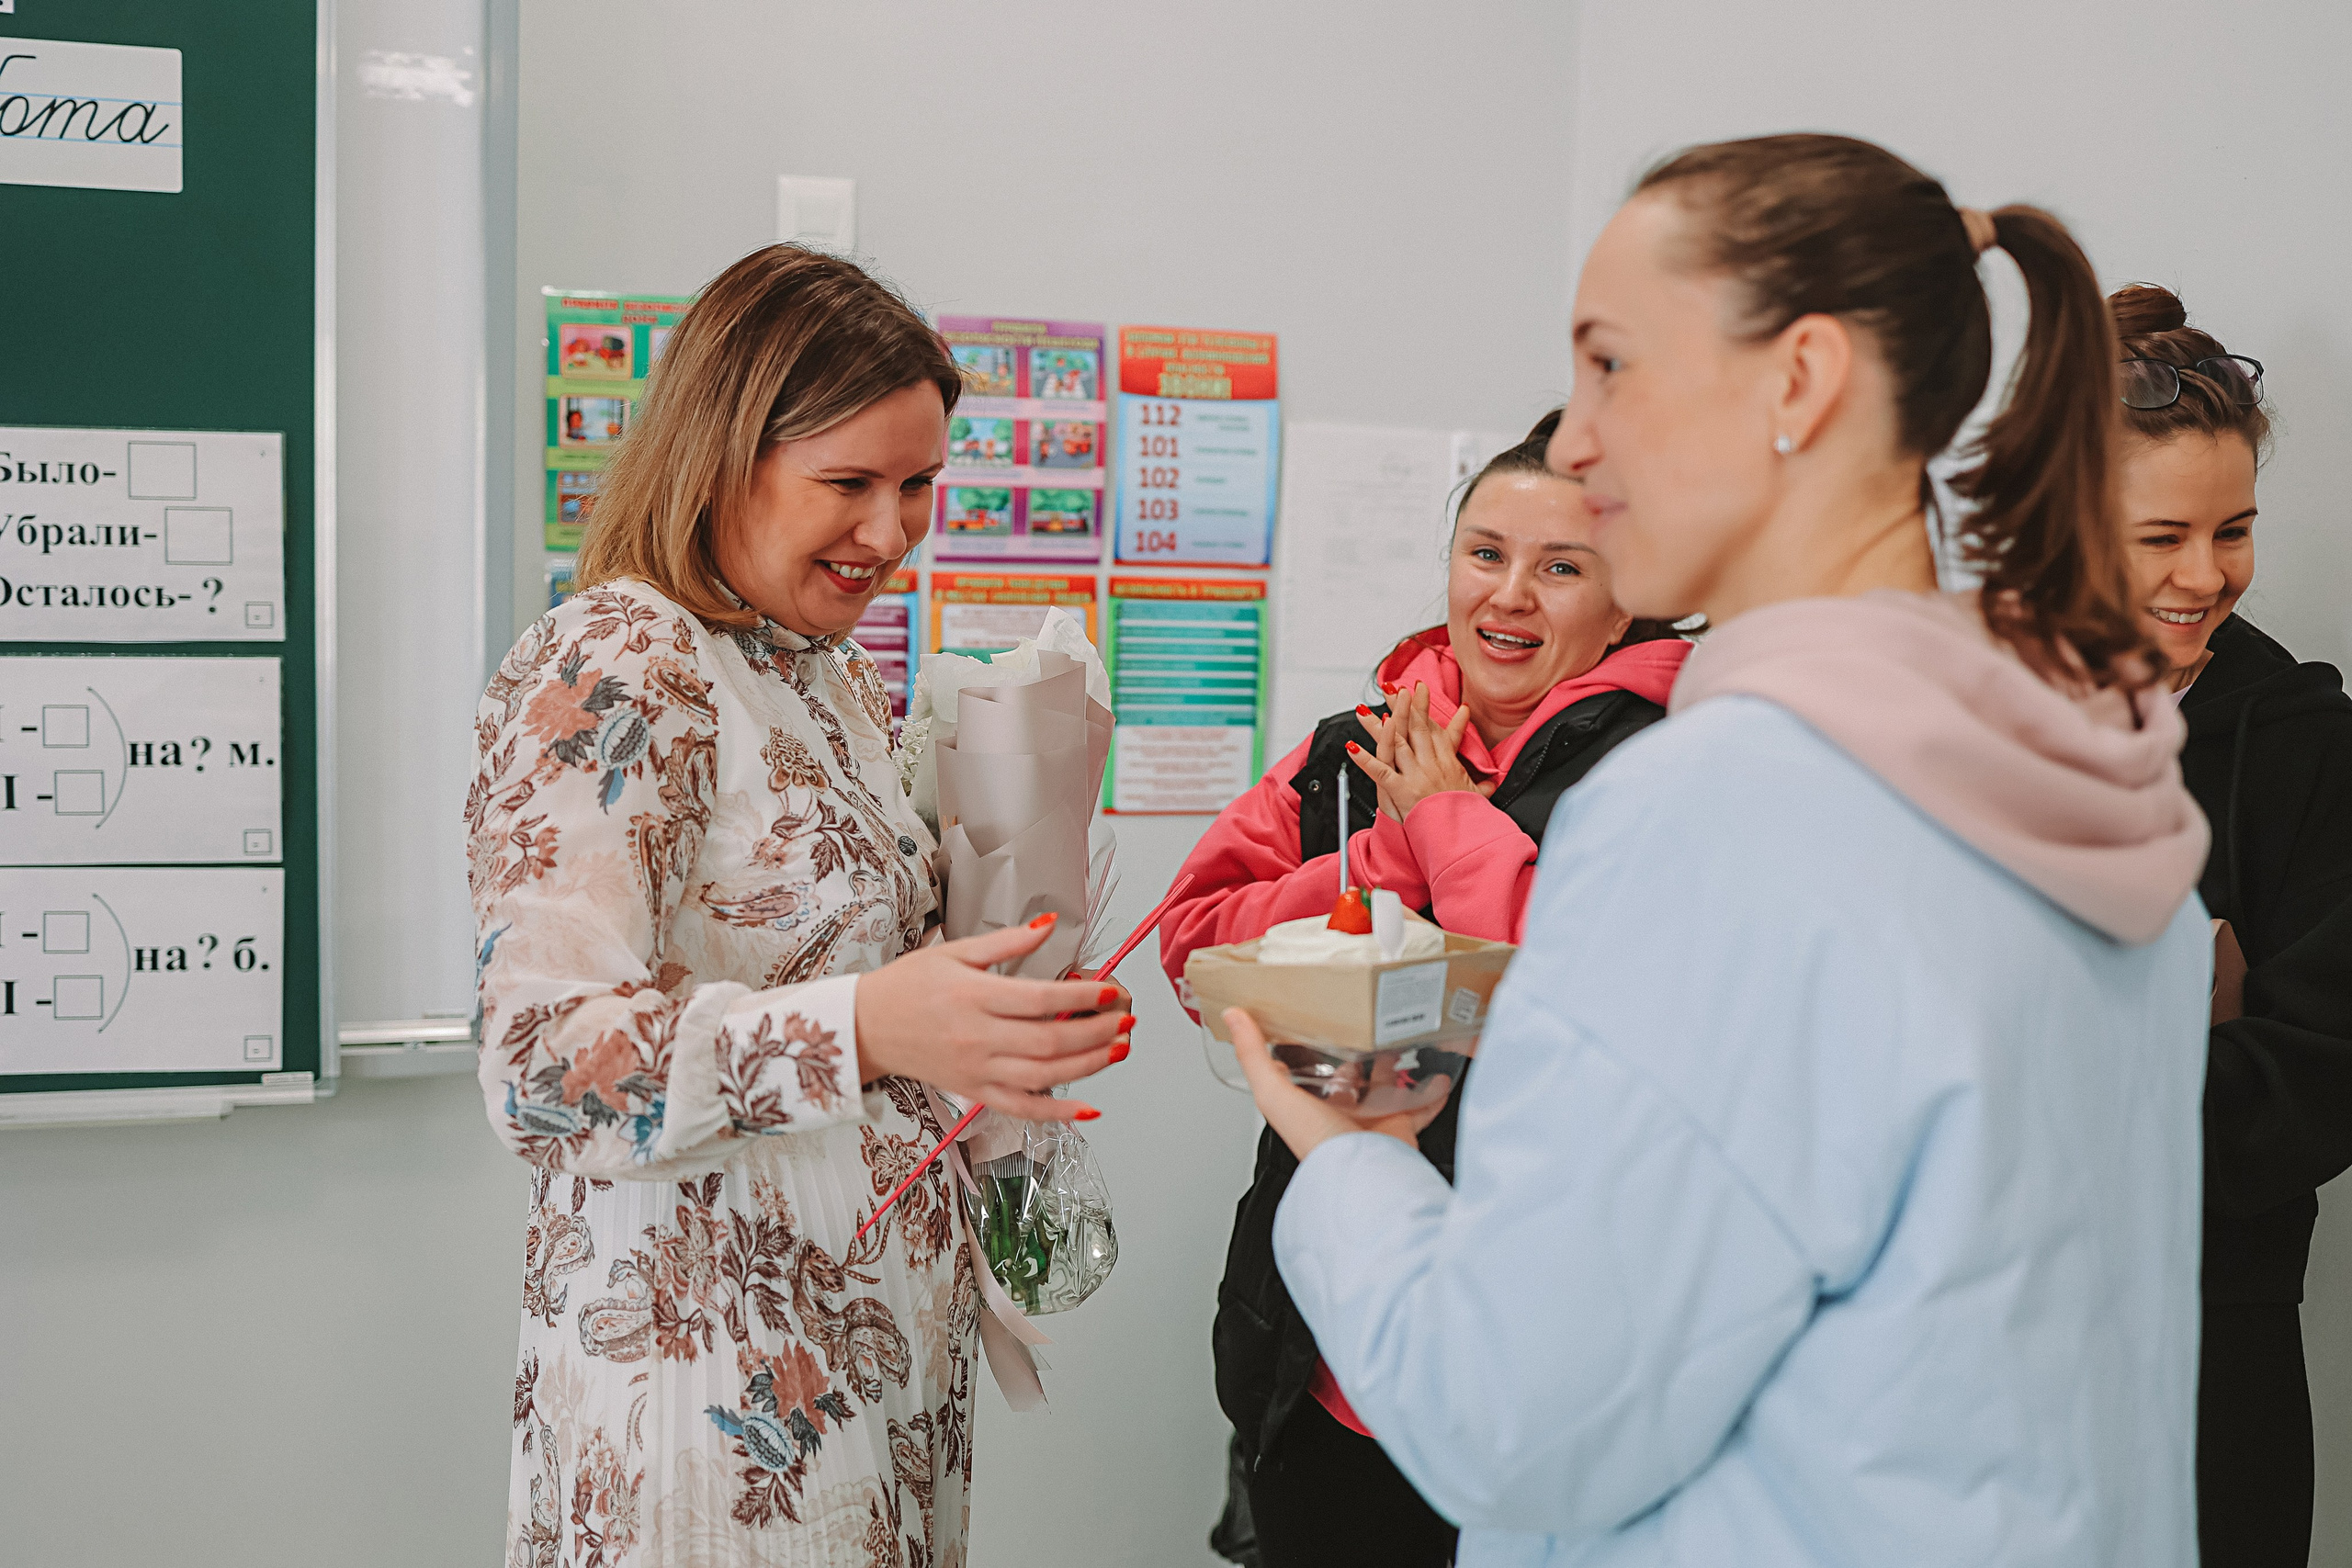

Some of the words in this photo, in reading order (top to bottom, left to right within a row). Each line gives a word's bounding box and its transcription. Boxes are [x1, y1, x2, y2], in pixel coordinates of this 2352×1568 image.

[0, 55, 169, 143] ота
[1140, 404, 1182, 426] 112
[1139, 435, 1179, 458] 101
[1139, 466, 1180, 490] 102
[1138, 498, 1179, 522] 103
[1136, 530, 1177, 552] 104
